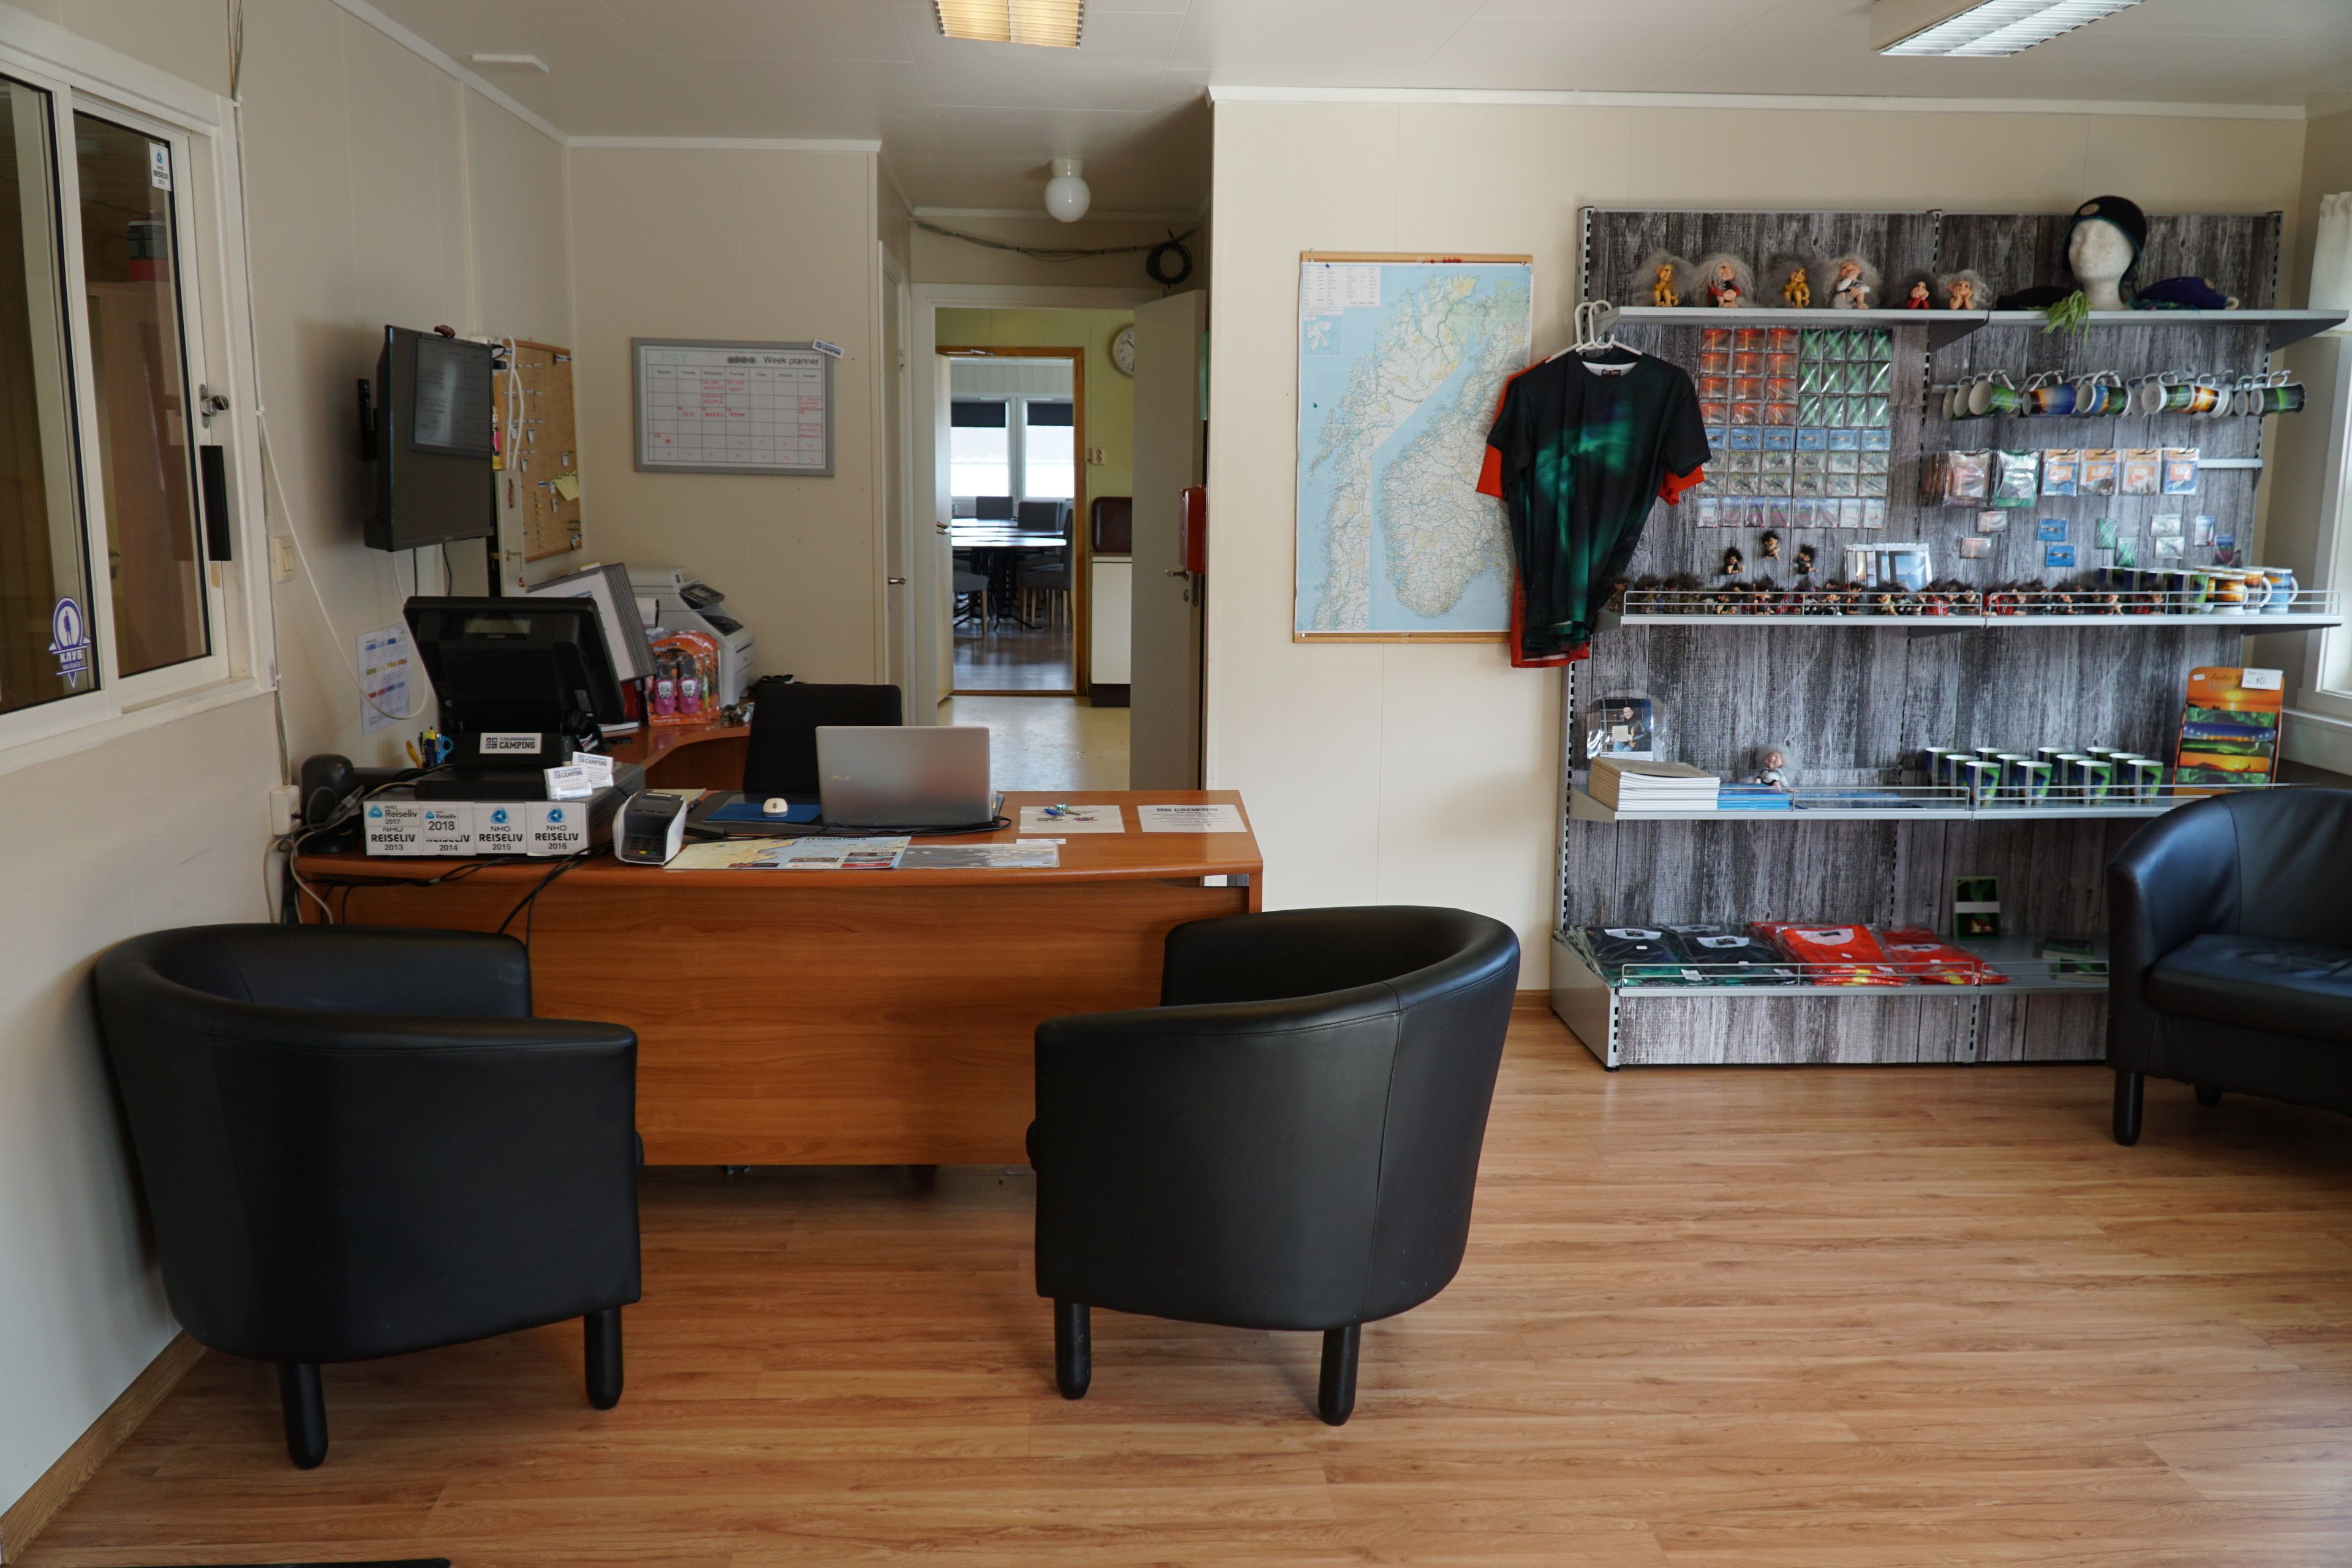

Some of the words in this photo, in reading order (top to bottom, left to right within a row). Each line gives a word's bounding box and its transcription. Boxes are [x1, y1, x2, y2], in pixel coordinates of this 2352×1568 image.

[153, 169, 168, 180] REISELIV
[789, 356, 819, 366] planner
[60, 650, 82, 663] КЛУБ
[429, 821, 455, 831] 2018
